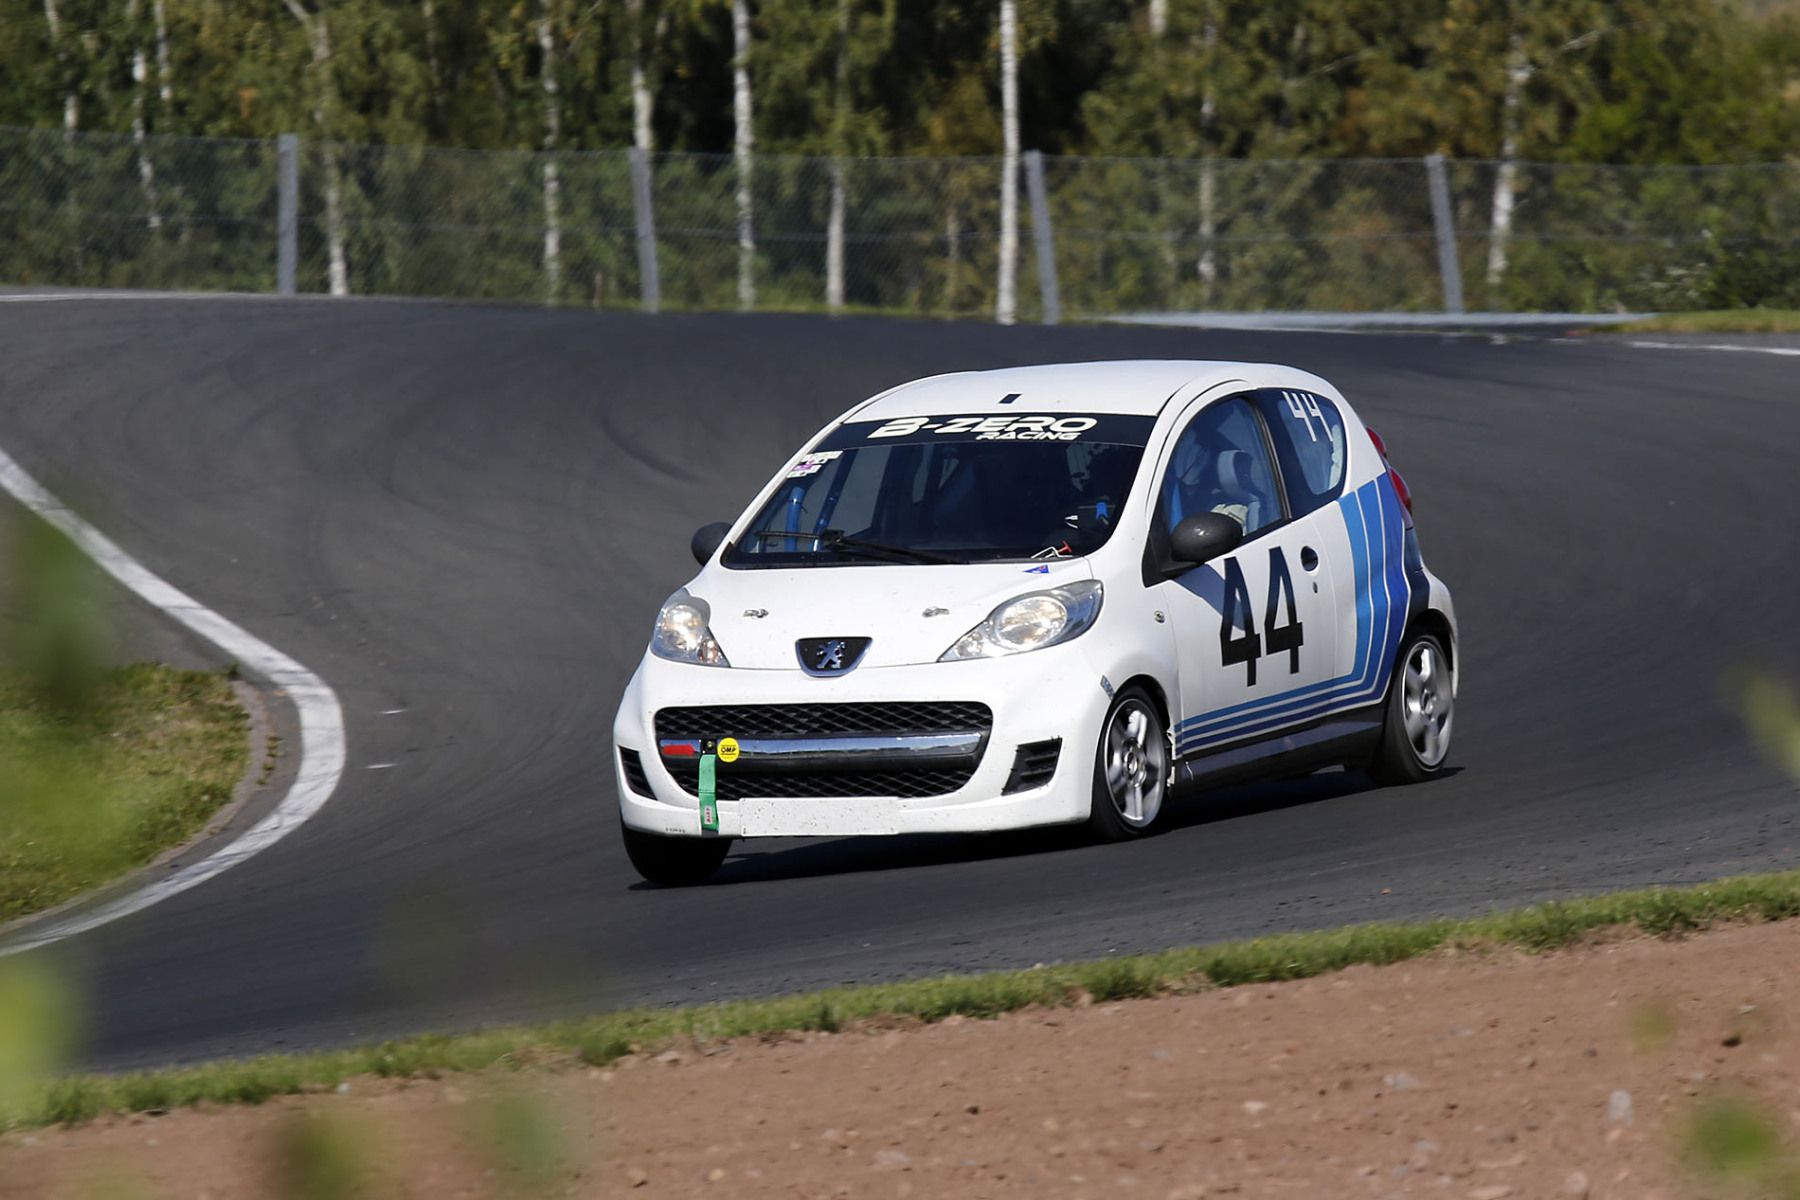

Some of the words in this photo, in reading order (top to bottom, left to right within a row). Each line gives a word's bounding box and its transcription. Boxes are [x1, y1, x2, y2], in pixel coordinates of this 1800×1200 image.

[867, 416, 1098, 439] B-ZERO
[1281, 390, 1334, 442] 44
[975, 431, 1082, 441] RACING
[1219, 545, 1304, 687] 44
